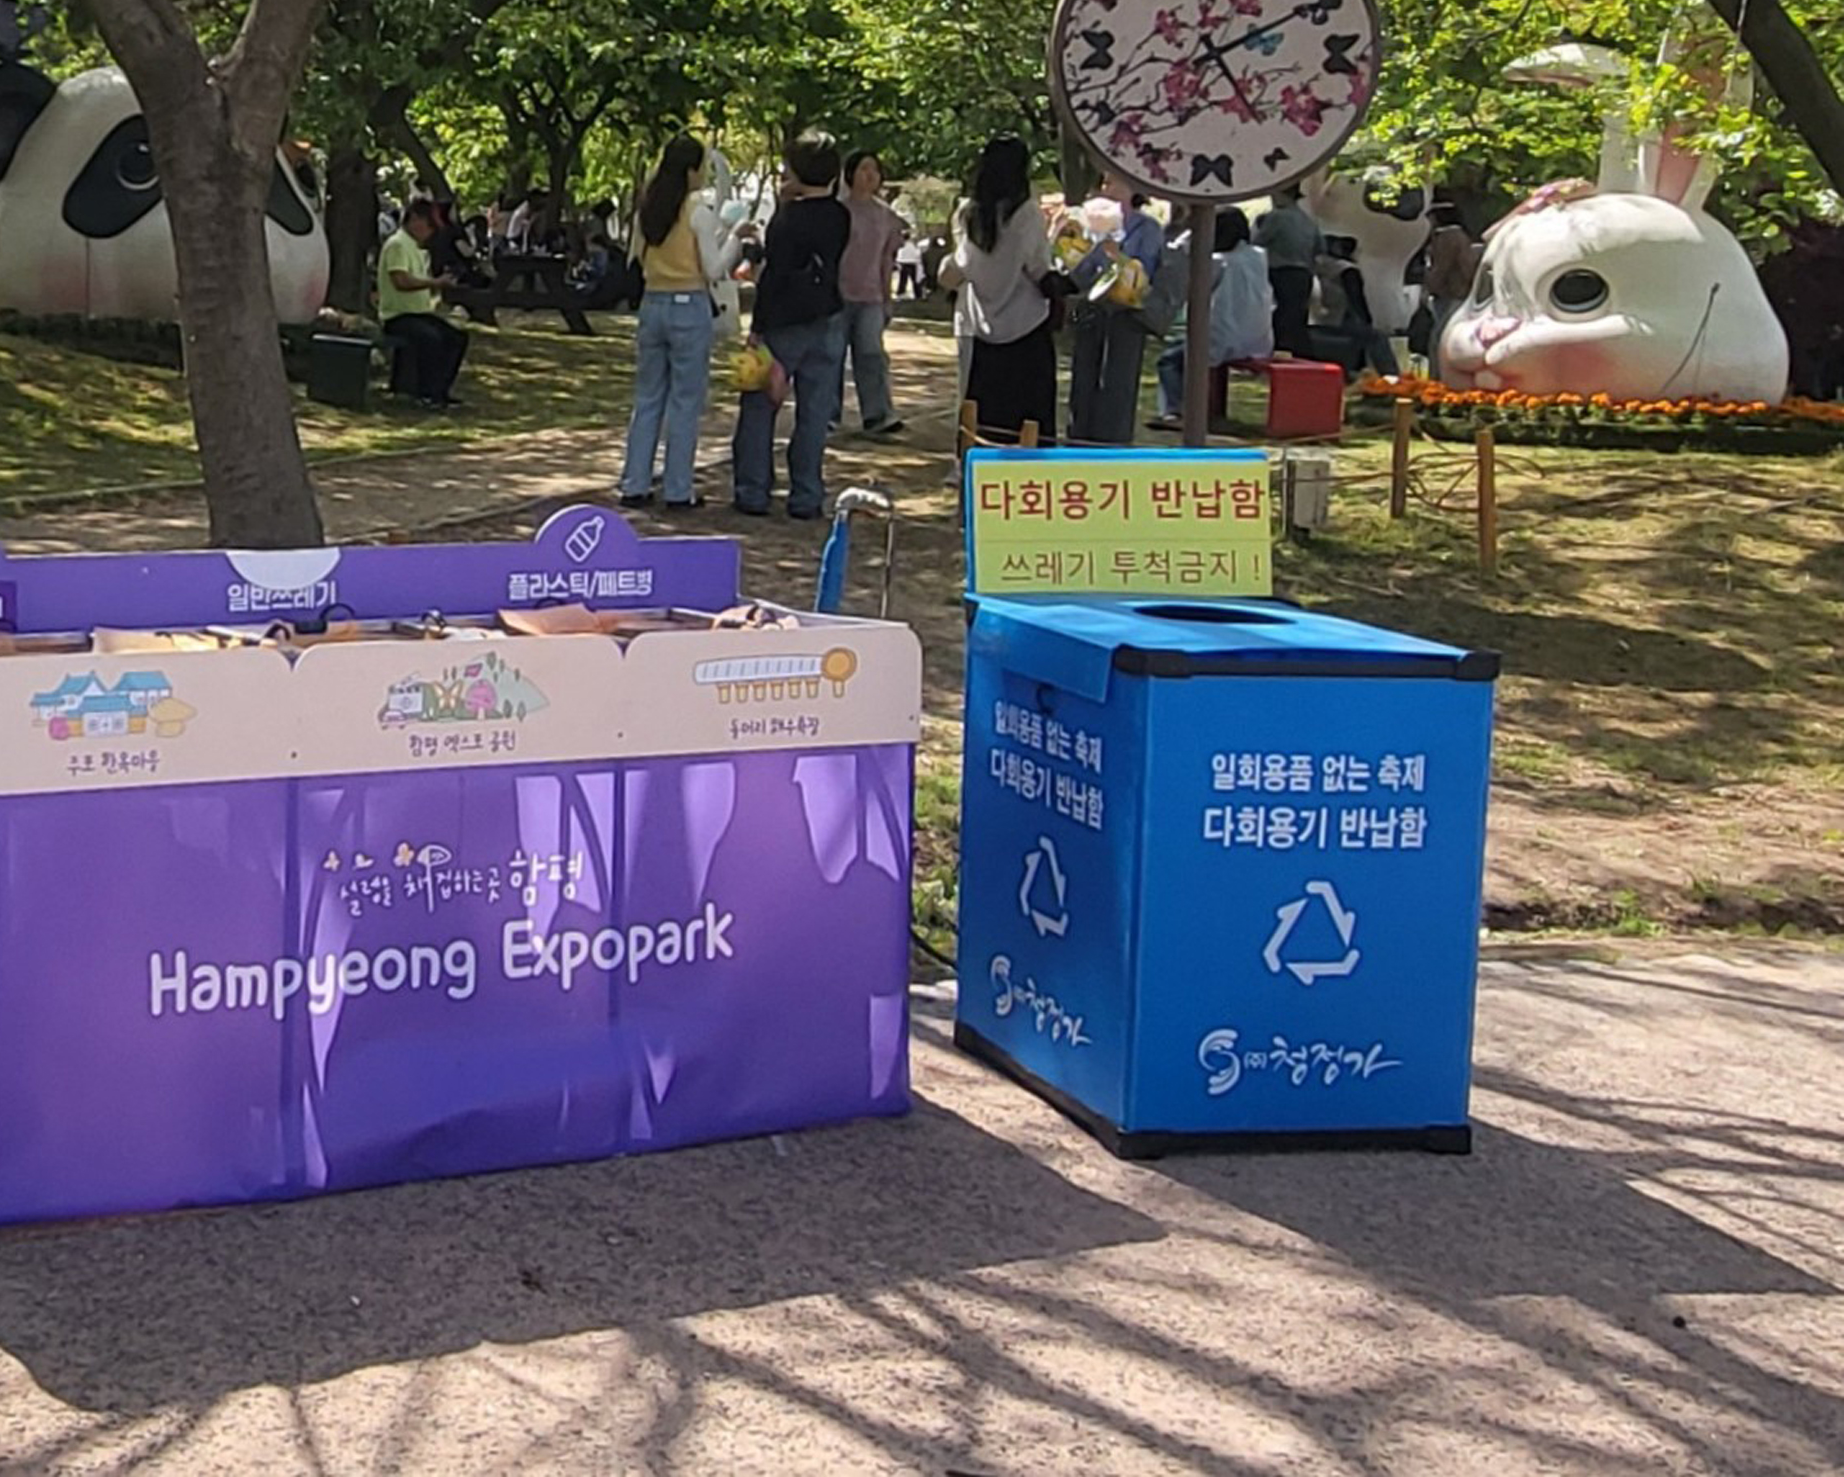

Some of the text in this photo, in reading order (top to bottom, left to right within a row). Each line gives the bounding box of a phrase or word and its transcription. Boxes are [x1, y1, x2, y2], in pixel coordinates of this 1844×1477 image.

[981, 479, 1266, 521] 다회용기 반납함
[1001, 550, 1096, 586] 쓰레기
[1110, 550, 1239, 585] 투척금지
[994, 700, 1102, 774] 일회용품 없는 축제
[991, 748, 1104, 830] 다회용기 반납함
[1211, 753, 1426, 792] 일회용품 없는 축제
[1203, 806, 1428, 849] 다회용기 반납함
[508, 849, 584, 907] 함평
[149, 900, 735, 1021] Hampyeong Expopark
